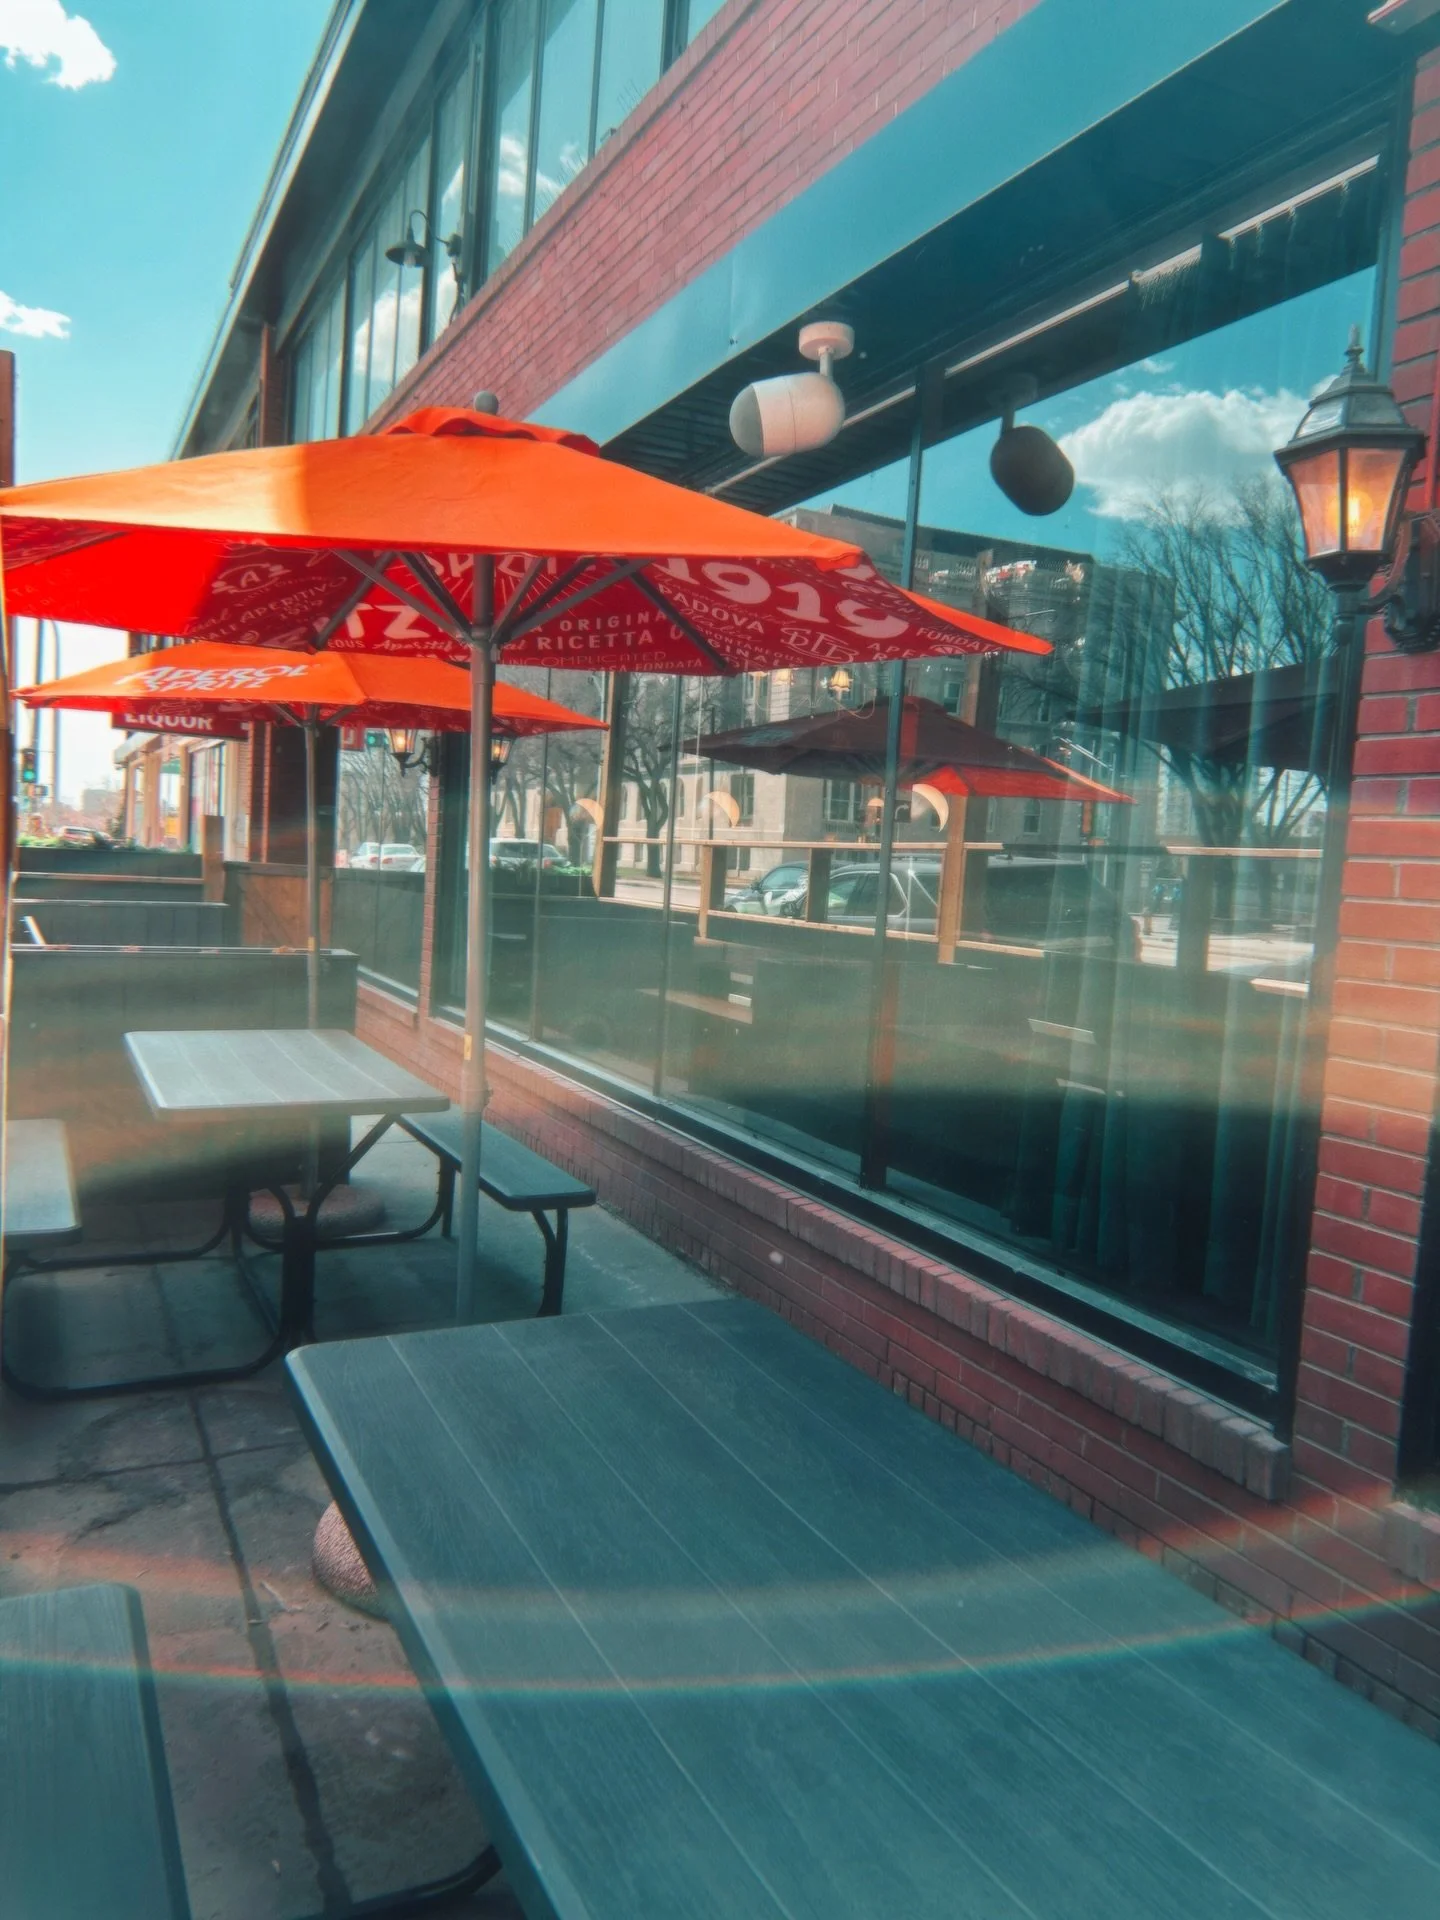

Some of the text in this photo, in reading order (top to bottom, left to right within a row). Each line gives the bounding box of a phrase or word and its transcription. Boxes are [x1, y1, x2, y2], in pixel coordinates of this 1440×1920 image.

[657, 582, 765, 634] PADOVA
[537, 631, 654, 650] RICETTA
[113, 664, 310, 686] APEROL
[144, 676, 272, 692] SPRITZ
